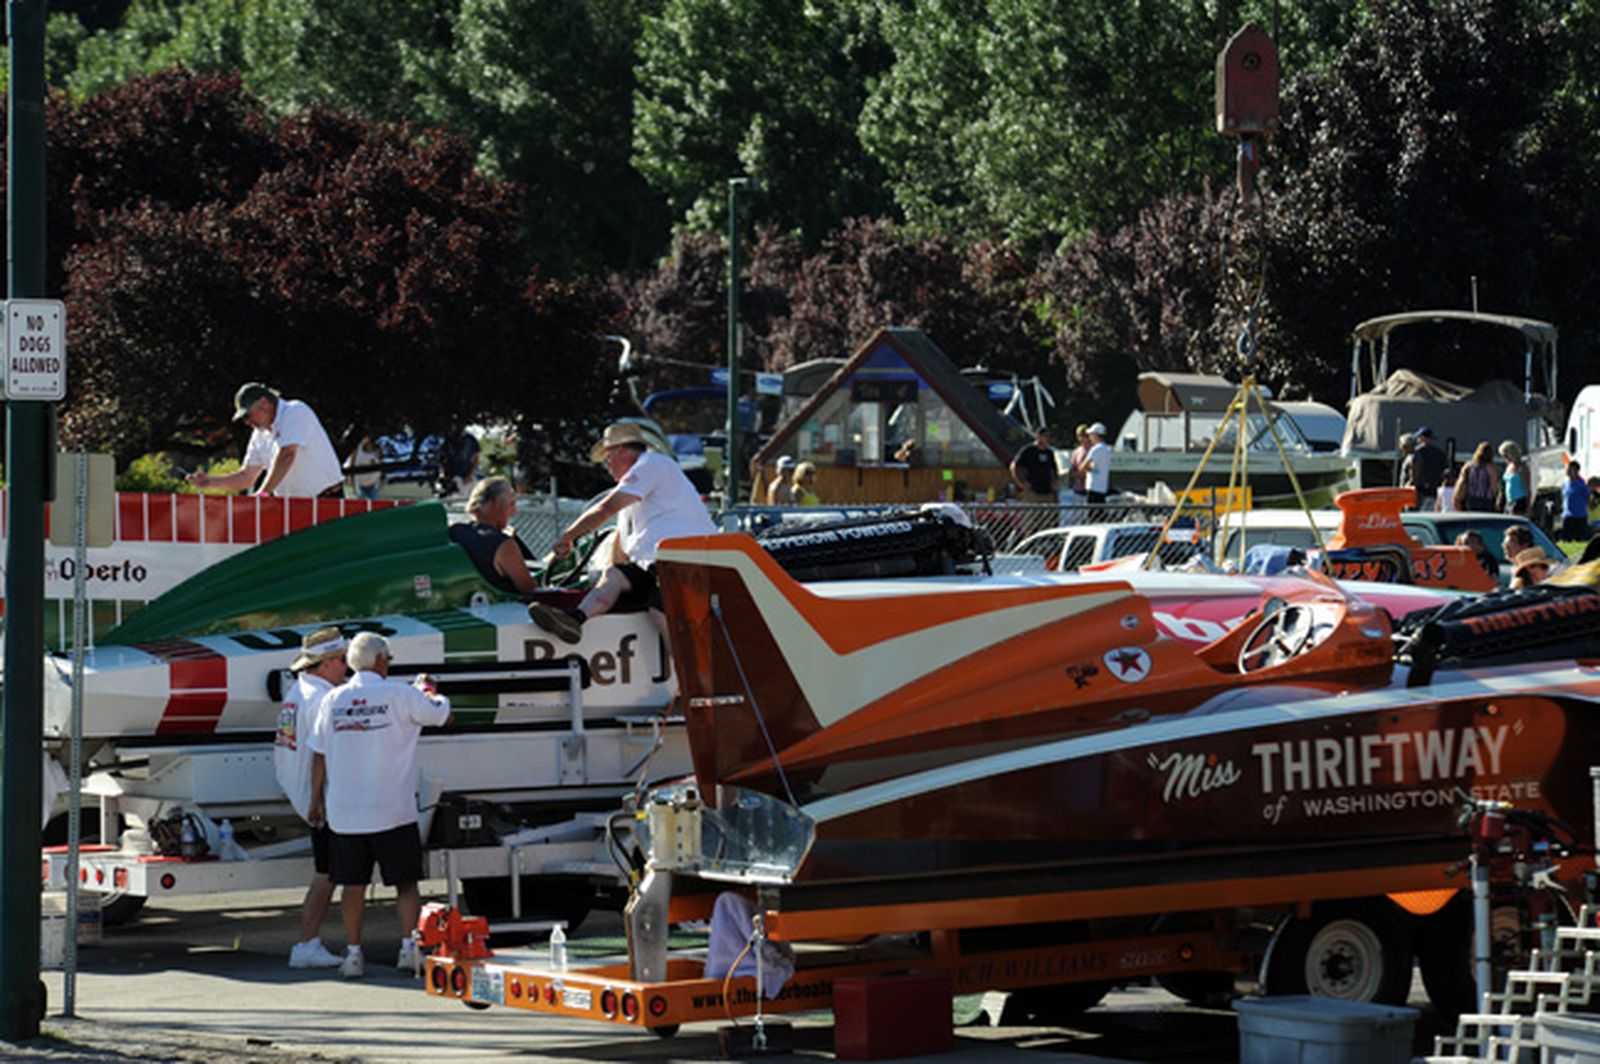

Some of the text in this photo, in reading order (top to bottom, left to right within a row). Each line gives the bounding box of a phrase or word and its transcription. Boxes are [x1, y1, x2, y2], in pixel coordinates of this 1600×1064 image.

[26, 315, 45, 331] NO
[19, 336, 51, 352] DOGS
[11, 357, 60, 373] ALLOWED
[524, 633, 637, 686] ef
[1263, 782, 1541, 825] of WASHINGTON STATE
